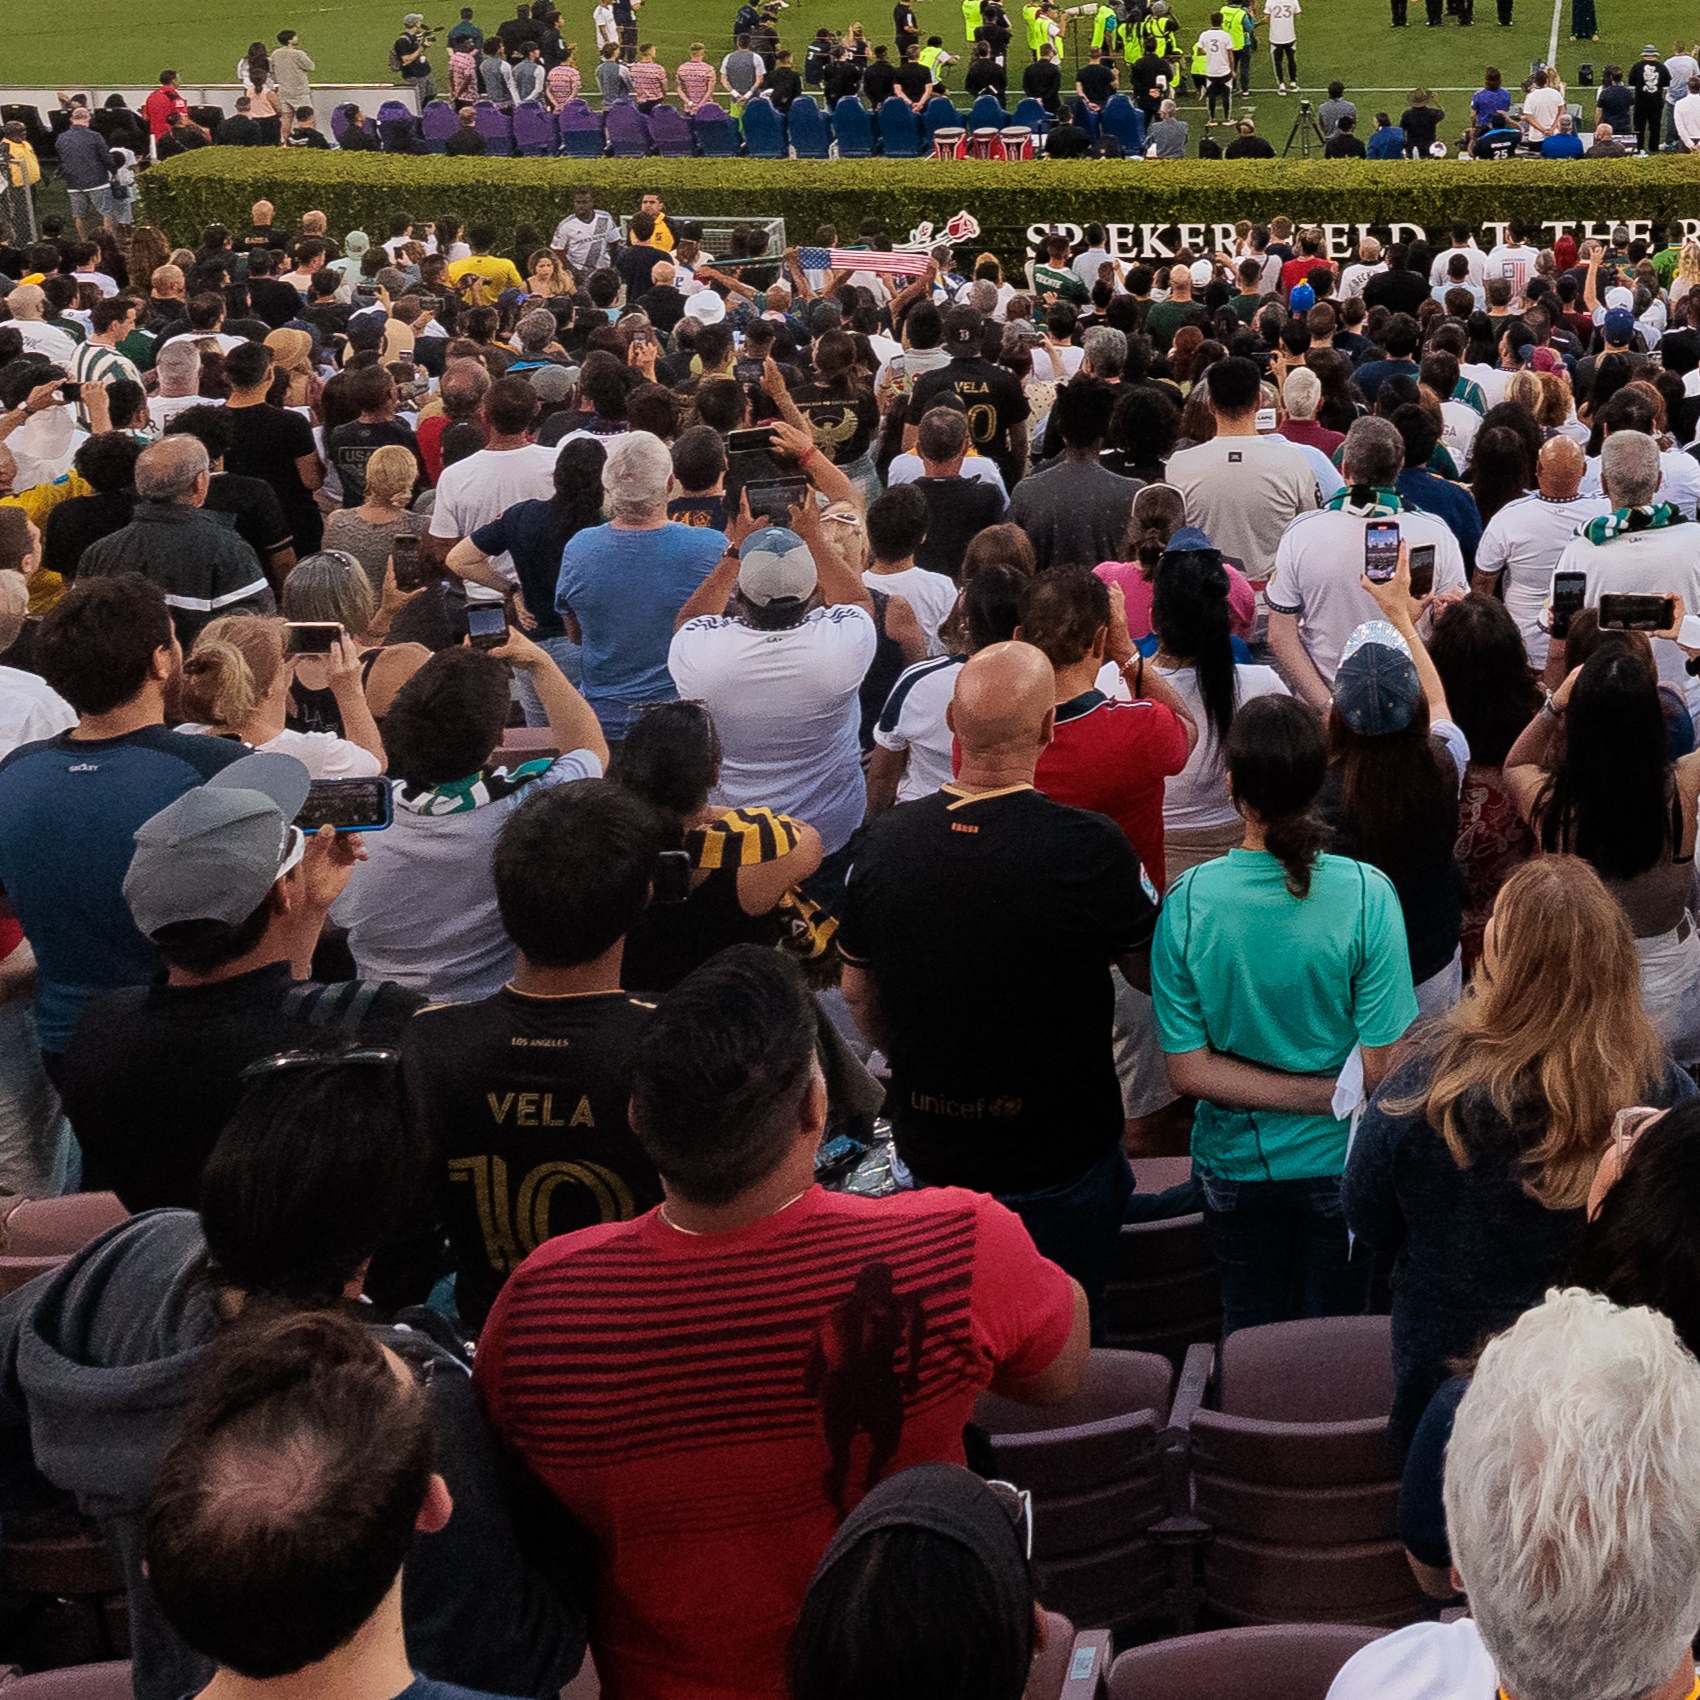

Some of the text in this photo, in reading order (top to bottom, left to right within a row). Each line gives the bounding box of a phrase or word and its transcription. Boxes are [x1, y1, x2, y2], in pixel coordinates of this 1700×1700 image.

[1273, 5, 1292, 18] 23
[1210, 38, 1219, 52] 3
[1493, 149, 1508, 159] 25
[1027, 223, 1240, 258] SPEKER
[1271, 222, 1427, 258] ELD
[1541, 220, 1653, 253] THE
[1352, 271, 1379, 287] BECK
[954, 382, 989, 393] VELA
[968, 403, 998, 442] 0
[512, 1037, 569, 1048] LOS ANGELES
[487, 1092, 595, 1128] VELA
[912, 1091, 984, 1119] unicef
[448, 1155, 636, 1273] 10
